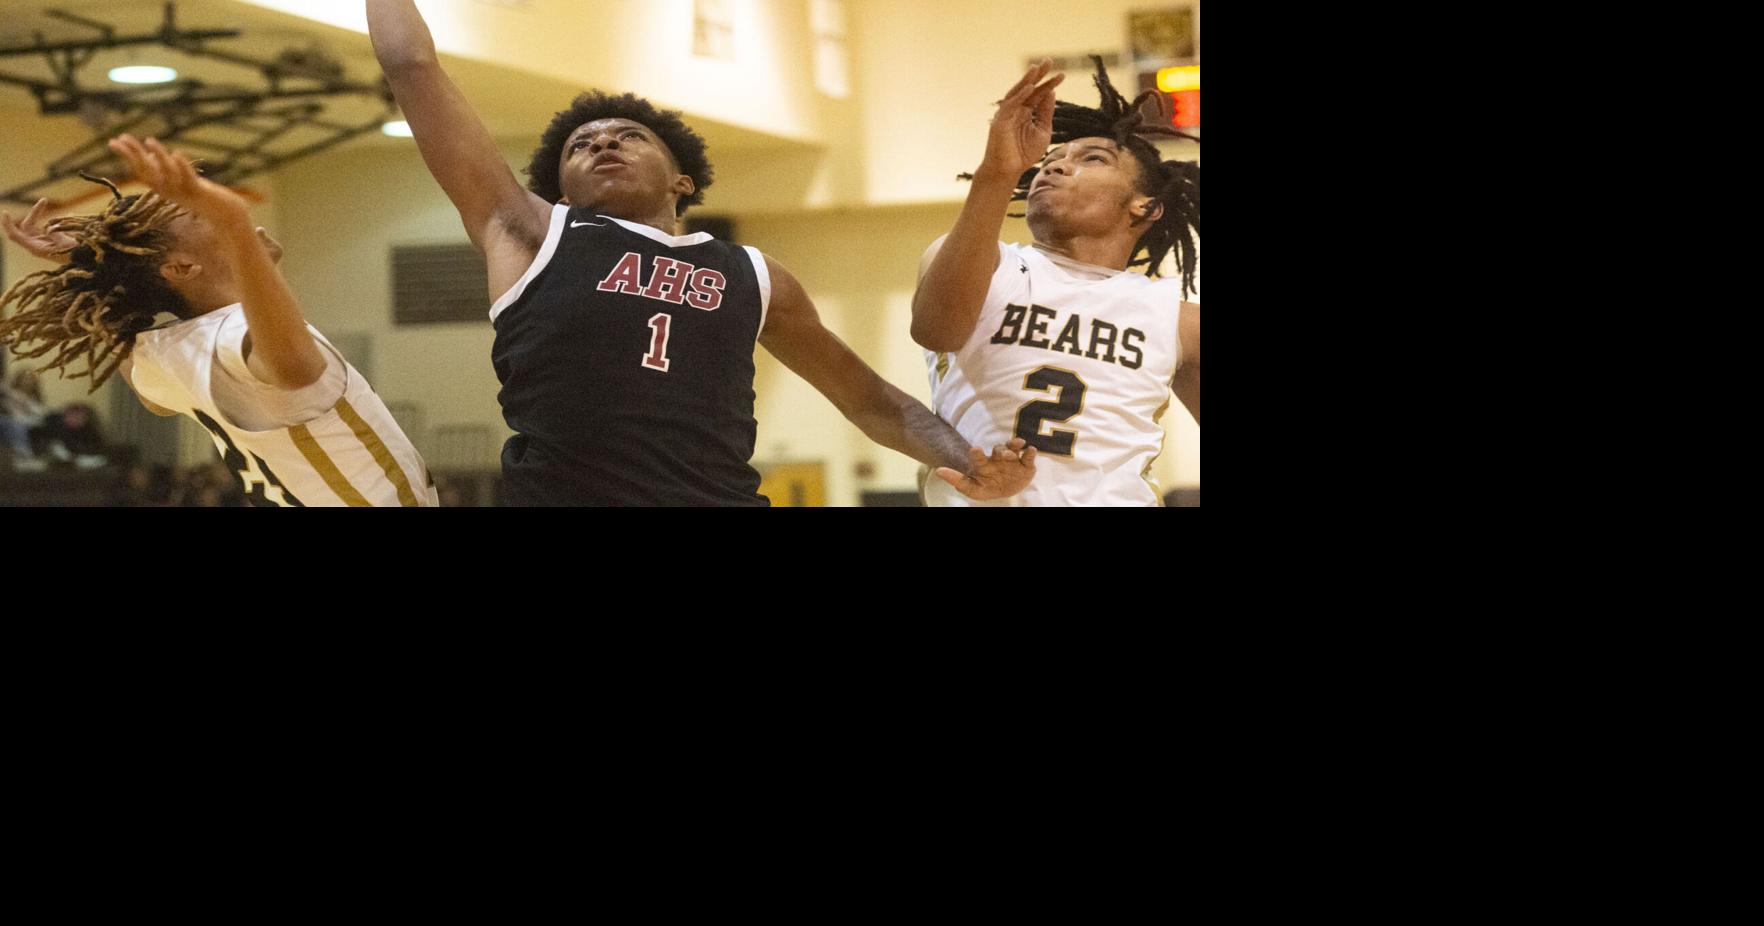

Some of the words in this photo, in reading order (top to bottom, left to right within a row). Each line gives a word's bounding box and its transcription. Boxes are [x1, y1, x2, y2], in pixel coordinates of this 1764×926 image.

[597, 252, 726, 311] AHS
[641, 312, 671, 373] 1
[990, 303, 1145, 370] BEARS
[1013, 365, 1088, 458] 2
